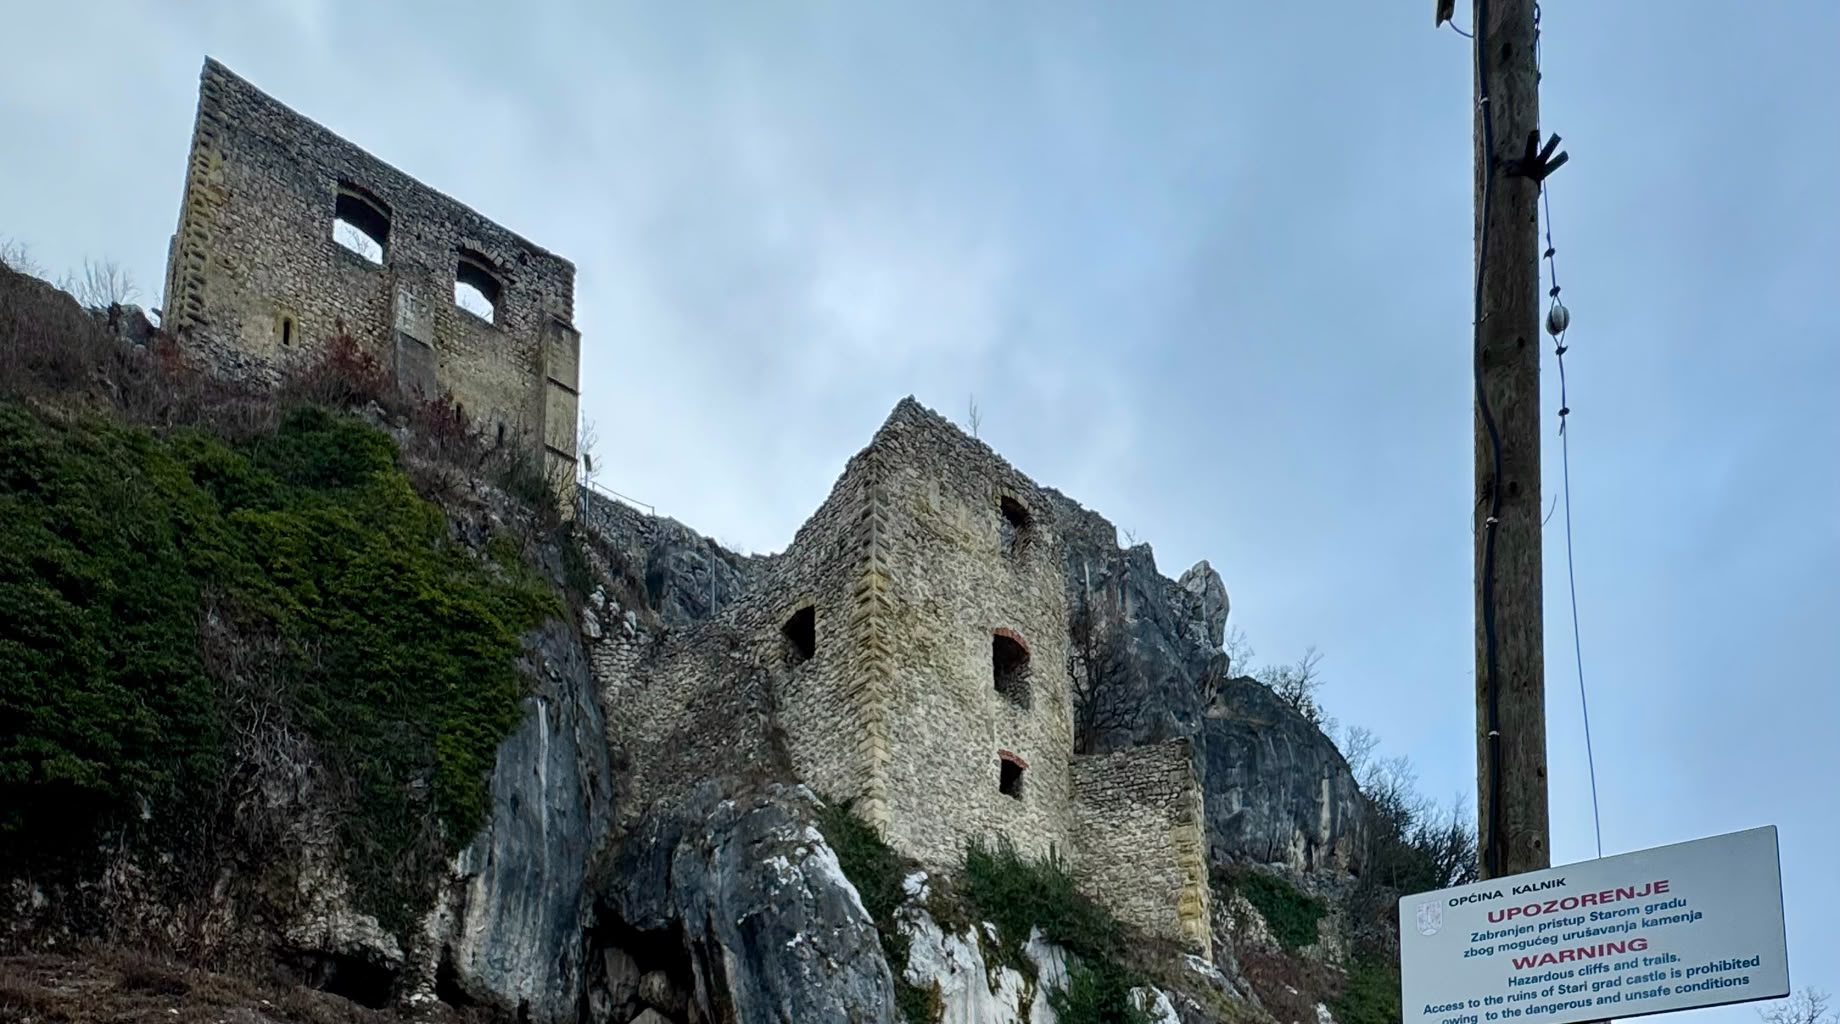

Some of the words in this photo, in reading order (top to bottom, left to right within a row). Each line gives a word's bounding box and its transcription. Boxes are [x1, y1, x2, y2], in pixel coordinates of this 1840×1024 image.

[1449, 890, 1503, 907] OPĆINA
[1512, 878, 1567, 895] KALNIK
[1488, 880, 1670, 923] UPOZORENJE
[1464, 945, 1494, 958] zbog
[1498, 935, 1559, 952] mogućeg
[1563, 921, 1637, 941] urušavanja
[1642, 910, 1703, 929] kamenja
[1471, 924, 1534, 943] Zabranjen
[1538, 915, 1585, 933] pristup
[1589, 906, 1640, 922] Starom
[1645, 897, 1687, 915] gradu
[1508, 968, 1574, 987] Hazardous
[1578, 962, 1610, 976] cliffs
[1614, 957, 1639, 971] and
[1643, 952, 1680, 967] trails.
[1512, 938, 1648, 970] WARNING
[1423, 1000, 1464, 1015] Access
[1468, 998, 1480, 1008] to
[1484, 993, 1504, 1006] the
[1507, 989, 1537, 1002] ruins
[1541, 986, 1554, 998] of
[1558, 981, 1588, 995] Stari
[1592, 976, 1622, 992] grad
[1626, 970, 1666, 985] castle
[1671, 968, 1682, 978] is
[1686, 955, 1760, 979] prohibited
[1485, 1010, 1498, 1021] to
[1502, 1005, 1521, 1018] the
[1525, 997, 1592, 1016] dangerous
[1596, 991, 1621, 1005] and
[1625, 985, 1671, 1001] unsafe
[1675, 975, 1750, 994] conditions
